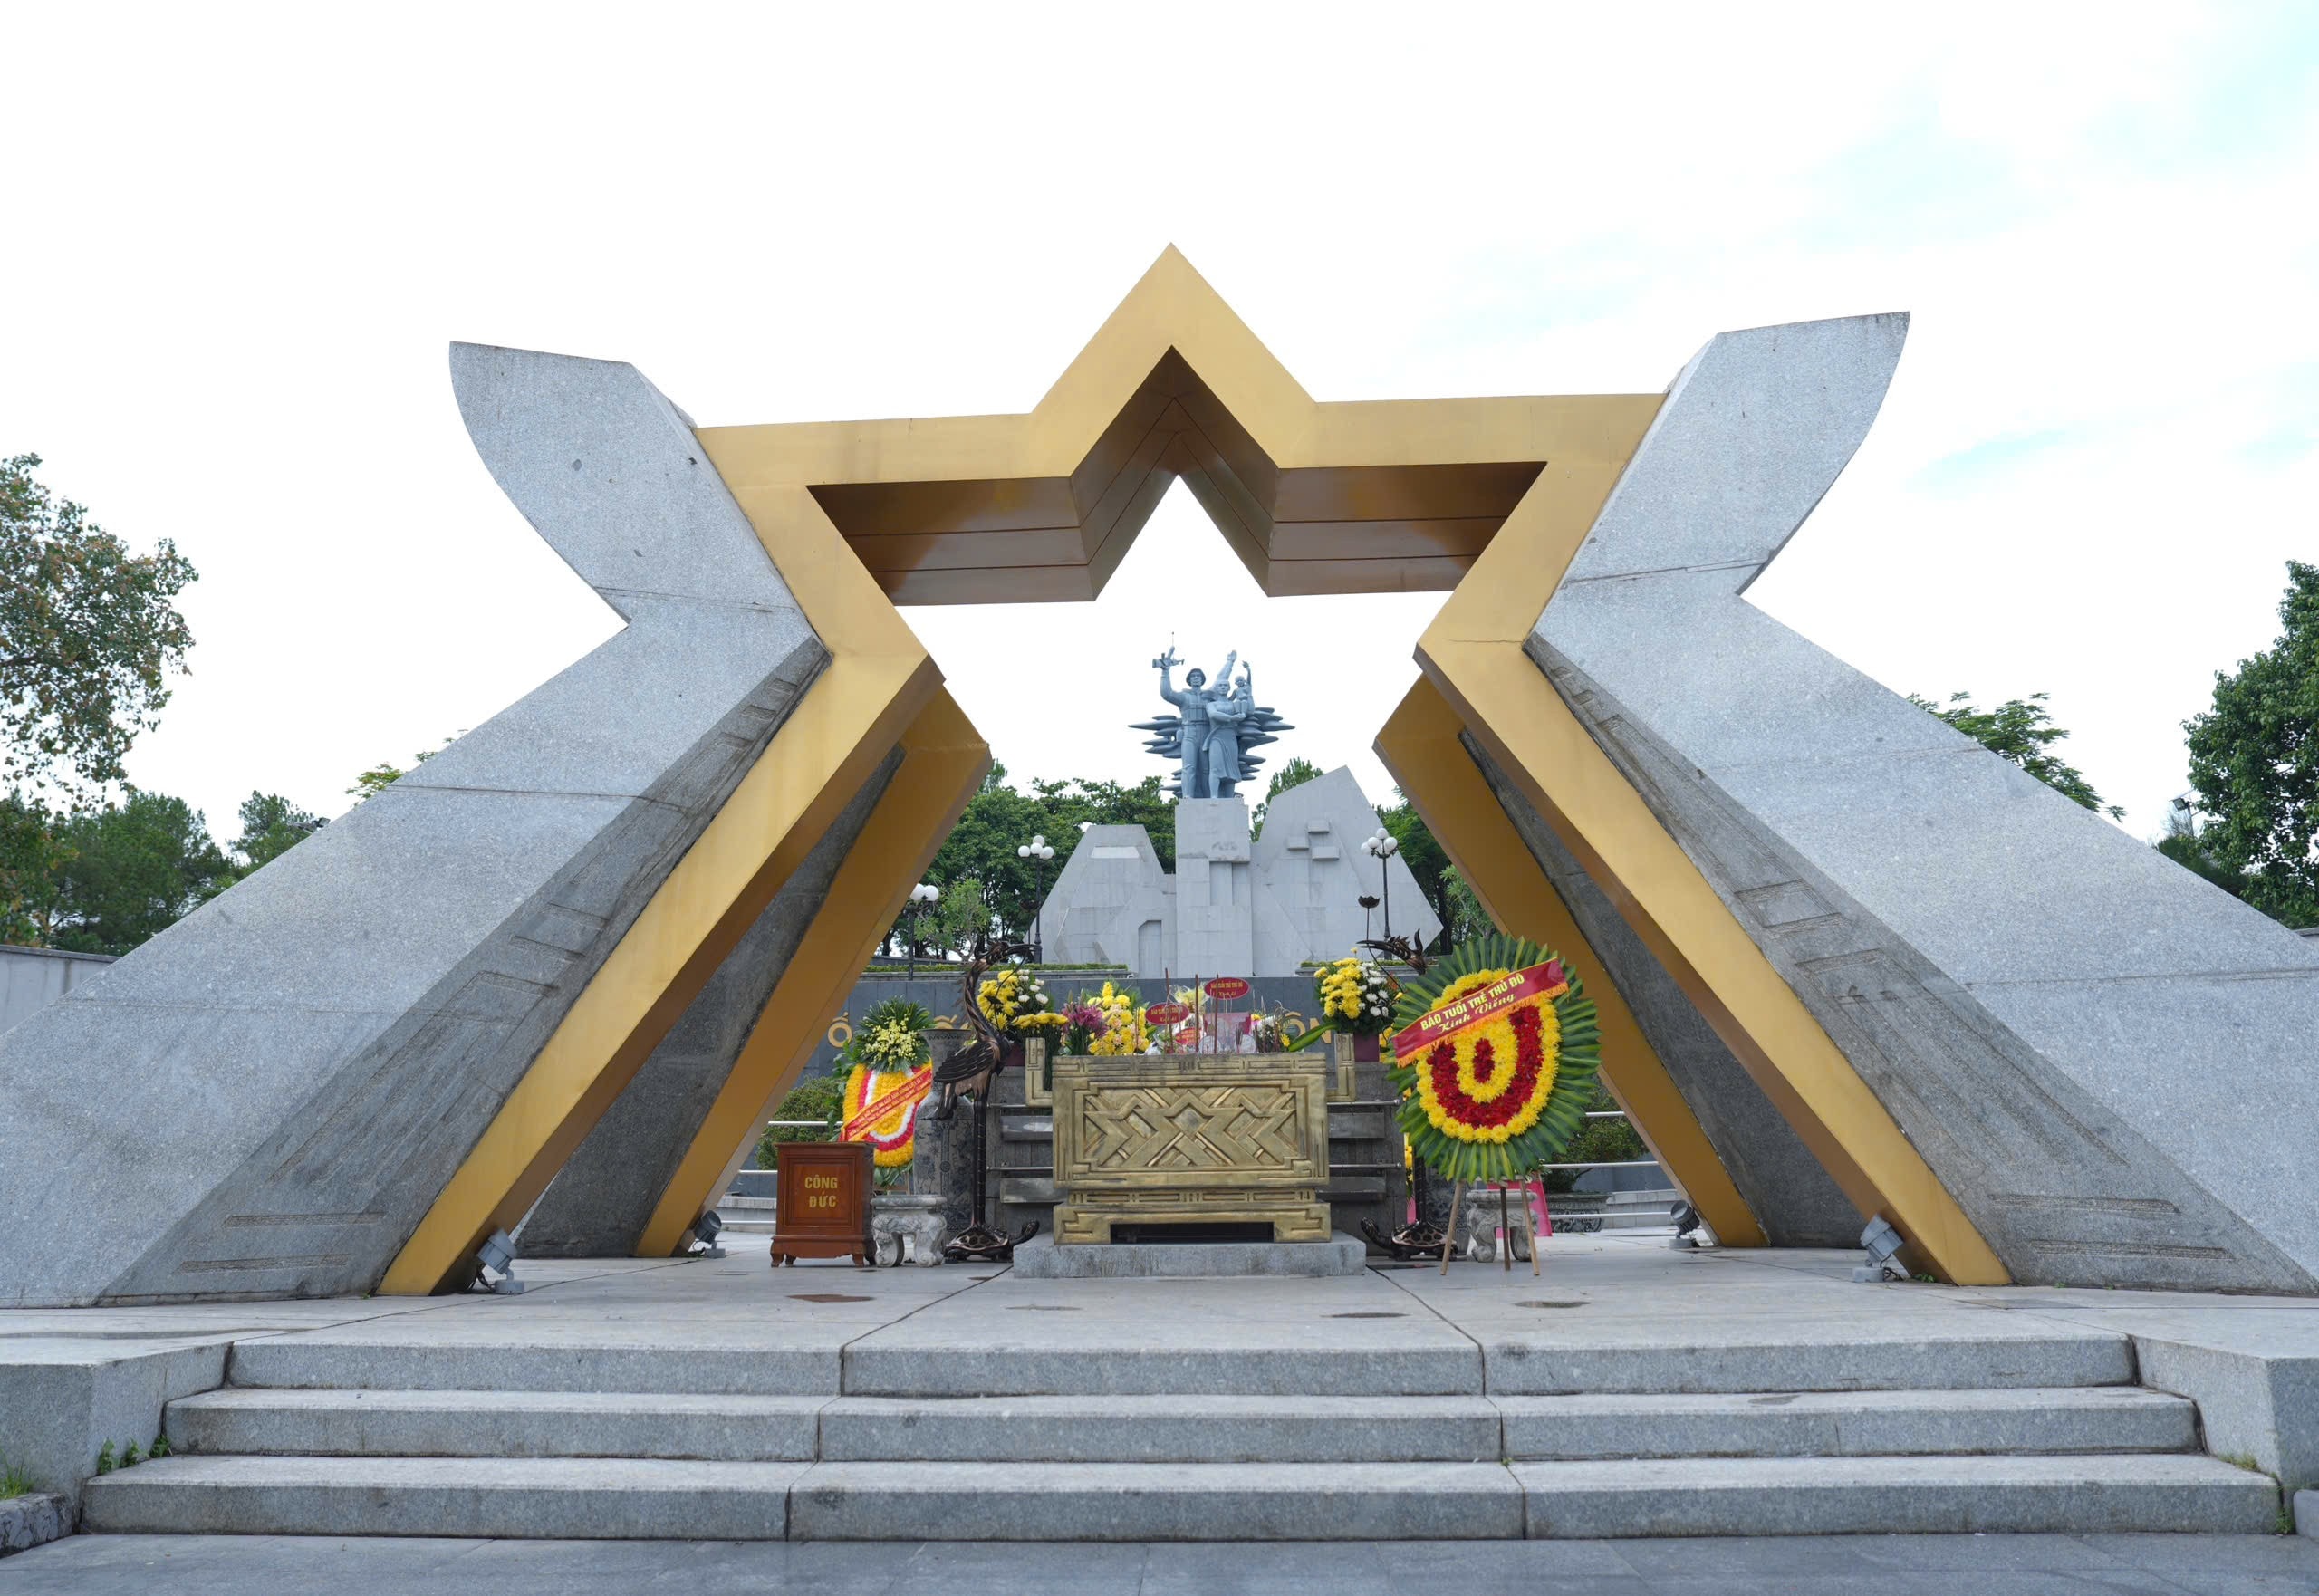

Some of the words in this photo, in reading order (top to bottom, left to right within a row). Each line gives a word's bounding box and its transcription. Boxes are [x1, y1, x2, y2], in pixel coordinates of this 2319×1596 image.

[1420, 1014, 1441, 1030] BÁO
[1443, 1004, 1467, 1020] TUỔI
[1488, 980, 1508, 998] THỦ
[1509, 973, 1525, 988] ĐÔ
[805, 1174, 837, 1189] CÔNG
[809, 1191, 837, 1208] ĐỨC
